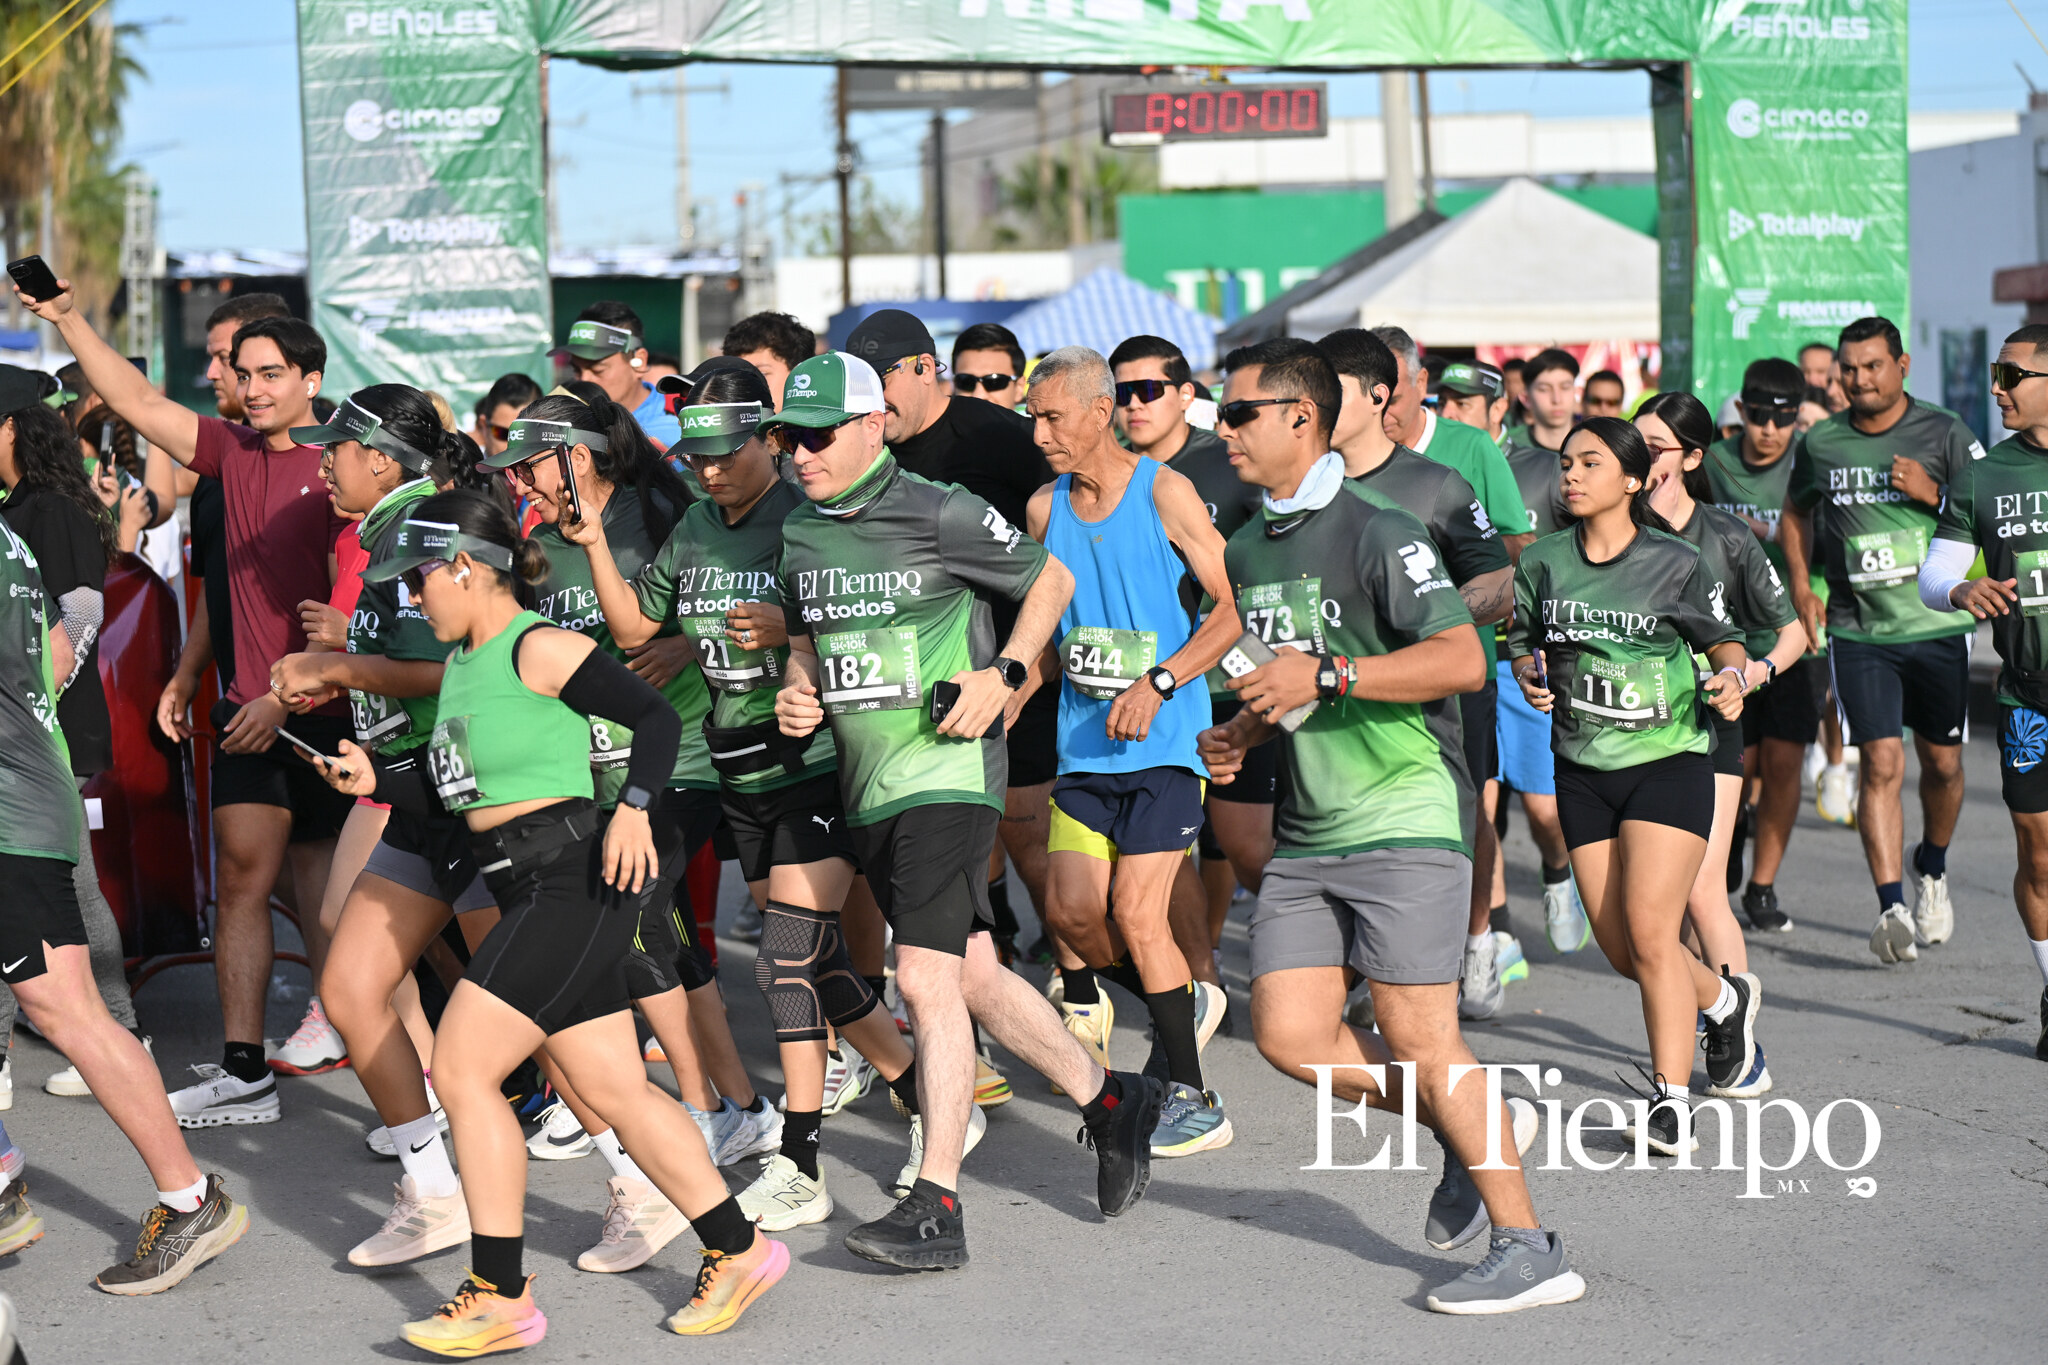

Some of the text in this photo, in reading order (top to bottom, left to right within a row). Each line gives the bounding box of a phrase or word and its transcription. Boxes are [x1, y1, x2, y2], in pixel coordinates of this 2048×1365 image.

[1764, 108, 1869, 128] cimaco
[383, 213, 501, 247] Totalplay
[1757, 209, 1865, 242] Totalplay
[1777, 301, 1877, 318] FRONTERA
[793, 389, 817, 398] Tiempo
[1829, 467, 1848, 490] El
[1833, 492, 1853, 506] de
[1994, 493, 2023, 520] El
[1997, 521, 2027, 538] de
[1861, 547, 1897, 573] 68
[679, 568, 696, 595] El
[798, 567, 922, 600] El Tiempo
[1252, 585, 1283, 595] CARRERA
[538, 594, 556, 618] El
[677, 600, 691, 616] de
[801, 599, 896, 623] de todos
[1542, 599, 1657, 635] El Tiempo
[829, 632, 867, 643] CARRERA
[1079, 627, 1114, 636] CARRERA
[1246, 606, 1296, 643] 573
[1308, 597, 1326, 654] MEDALLA
[1545, 630, 1566, 643] de
[701, 638, 731, 668] 21
[1069, 644, 1124, 677] 544
[1592, 657, 1626, 671] CARRERA
[824, 653, 884, 690] 182
[905, 644, 918, 699] MEDALLA
[1583, 674, 1641, 710] 116
[1654, 673, 1668, 719] MEDALLA
